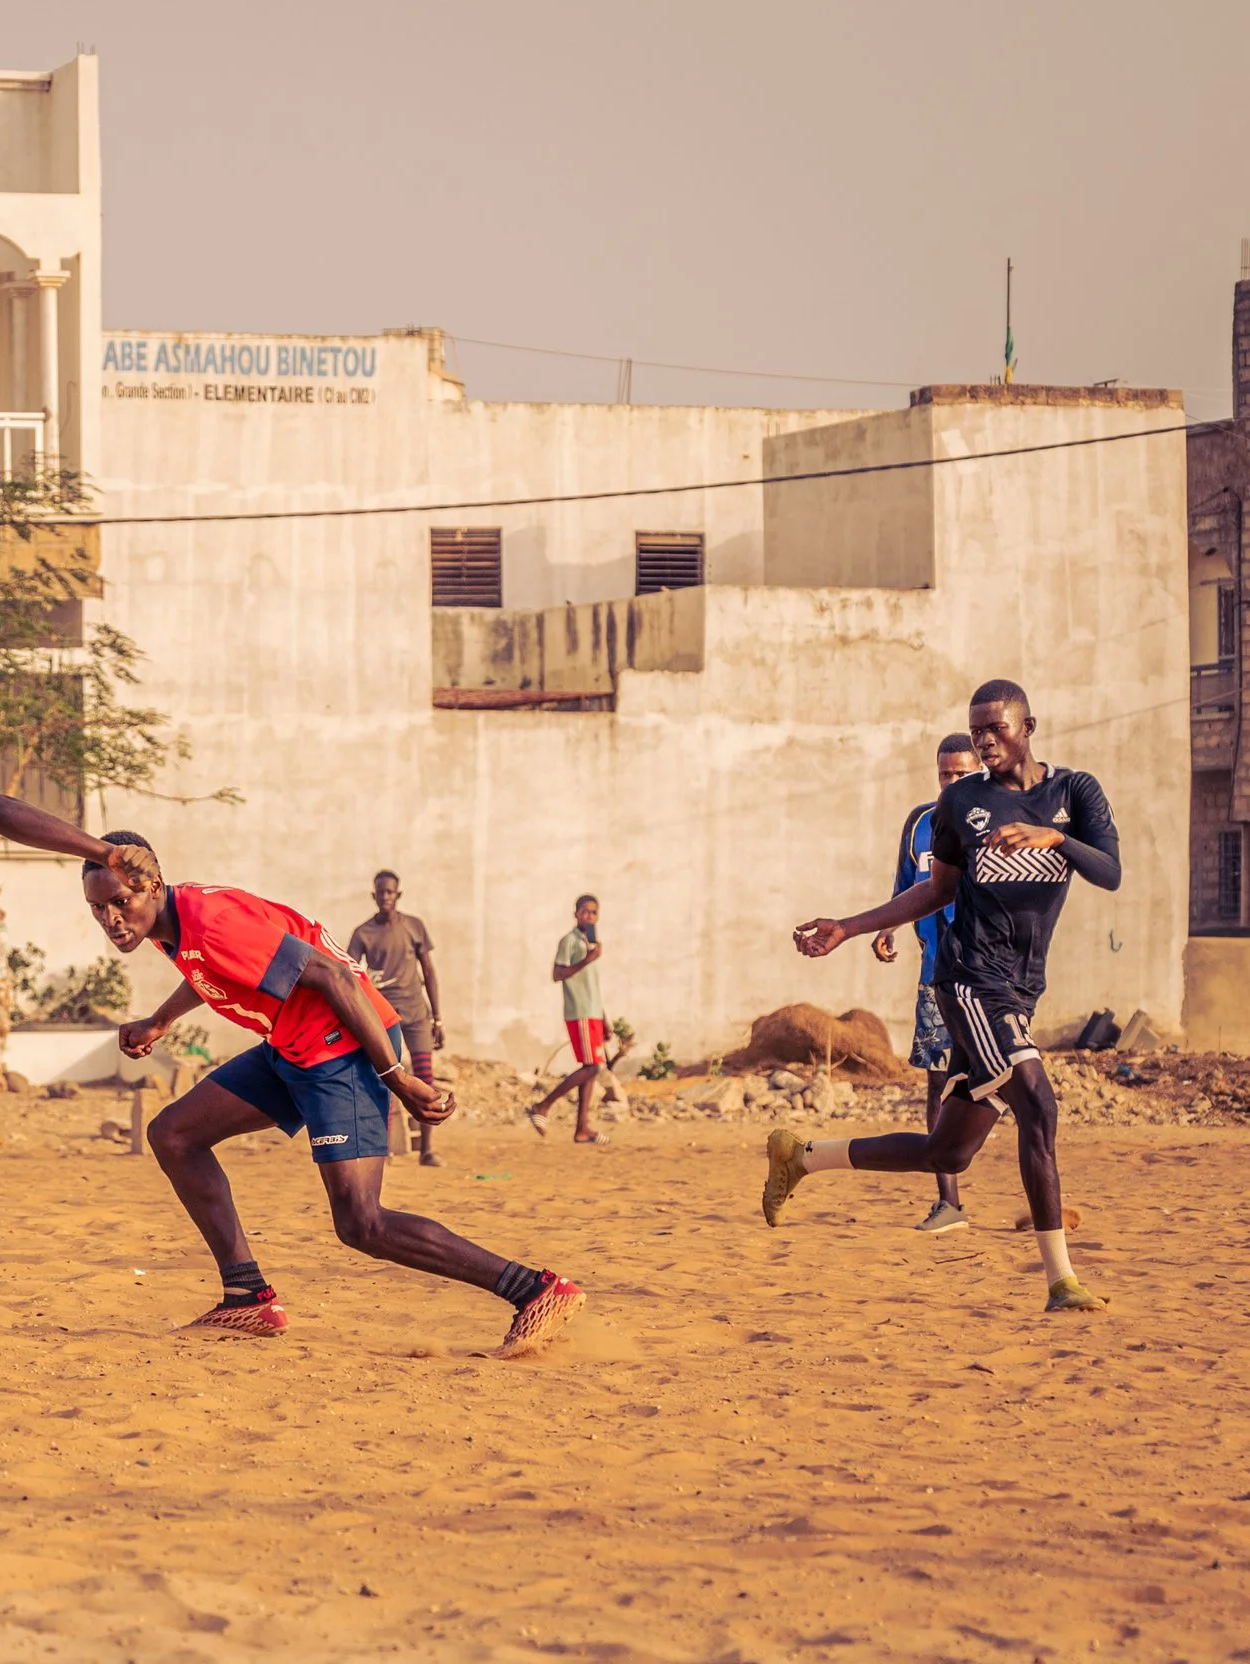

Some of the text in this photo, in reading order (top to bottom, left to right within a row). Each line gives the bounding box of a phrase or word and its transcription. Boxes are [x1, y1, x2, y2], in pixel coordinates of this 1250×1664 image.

[102, 340, 377, 378] ABE ASMAHOU BINETOU
[204, 384, 314, 404] ELEMENTAIRE
